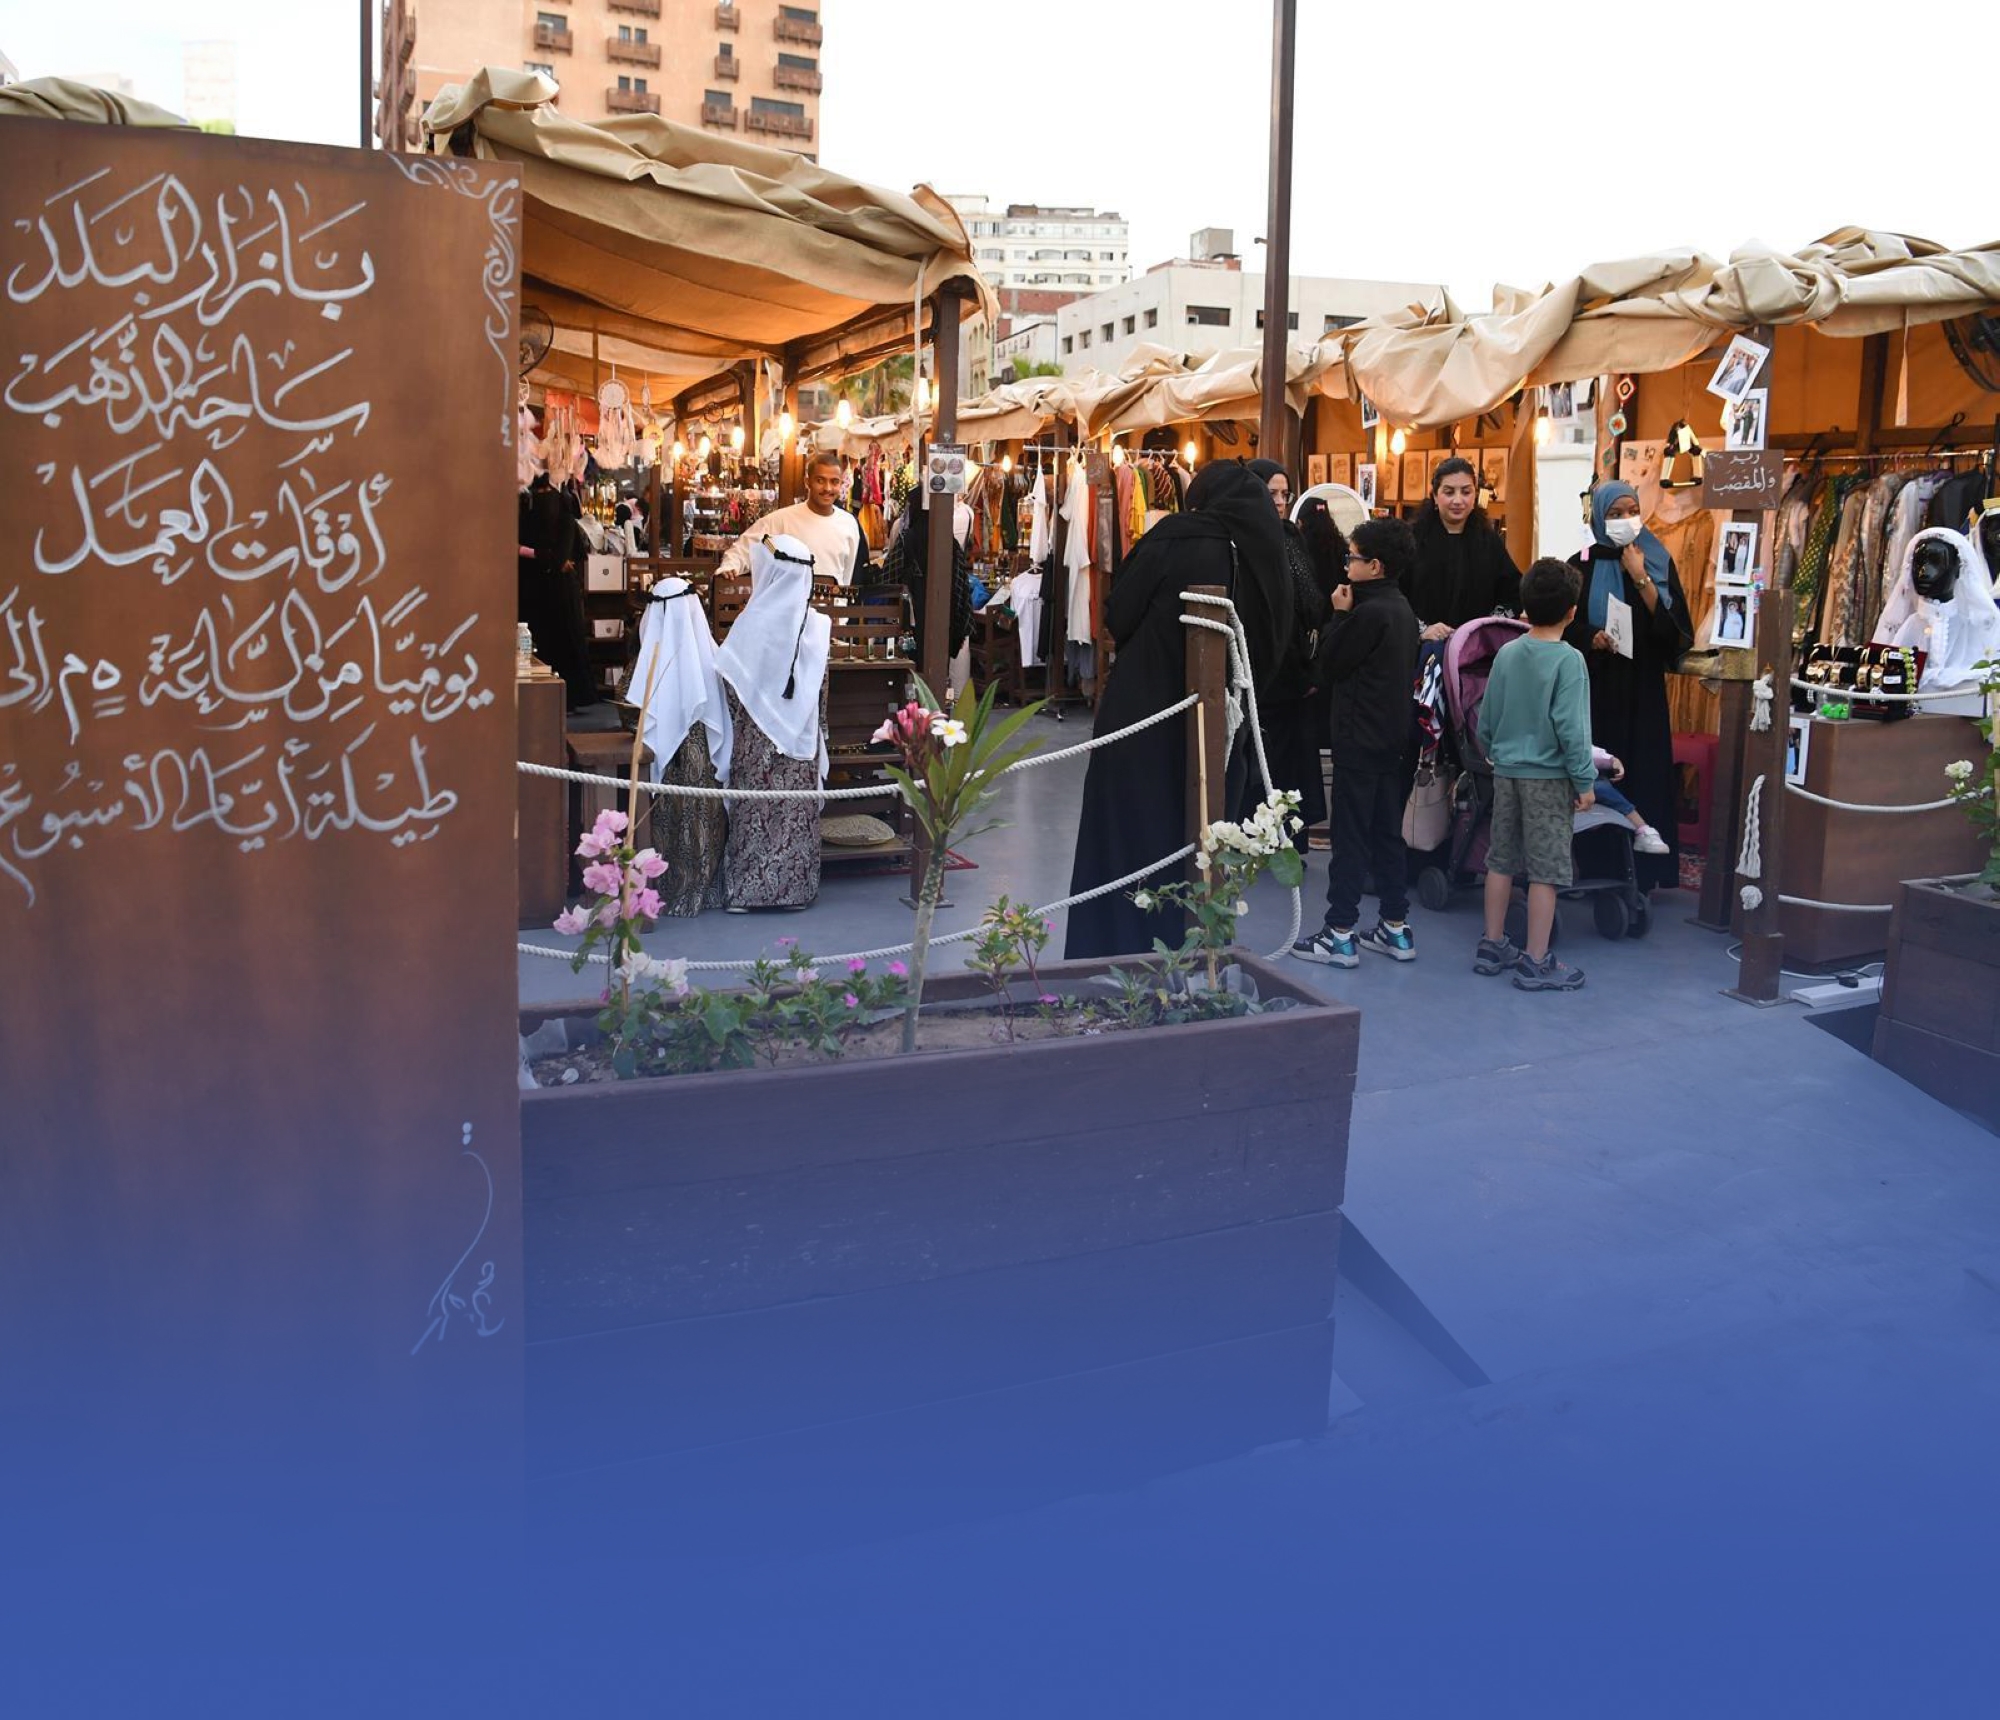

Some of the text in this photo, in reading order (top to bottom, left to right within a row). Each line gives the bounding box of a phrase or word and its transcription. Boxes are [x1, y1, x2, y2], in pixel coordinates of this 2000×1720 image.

[7, 167, 375, 325] بازار البلد
[34, 458, 393, 593] أوقات العمل
[138, 588, 322, 715] الساعة
[283, 610, 372, 721] من
[172, 739, 311, 853] أيام
